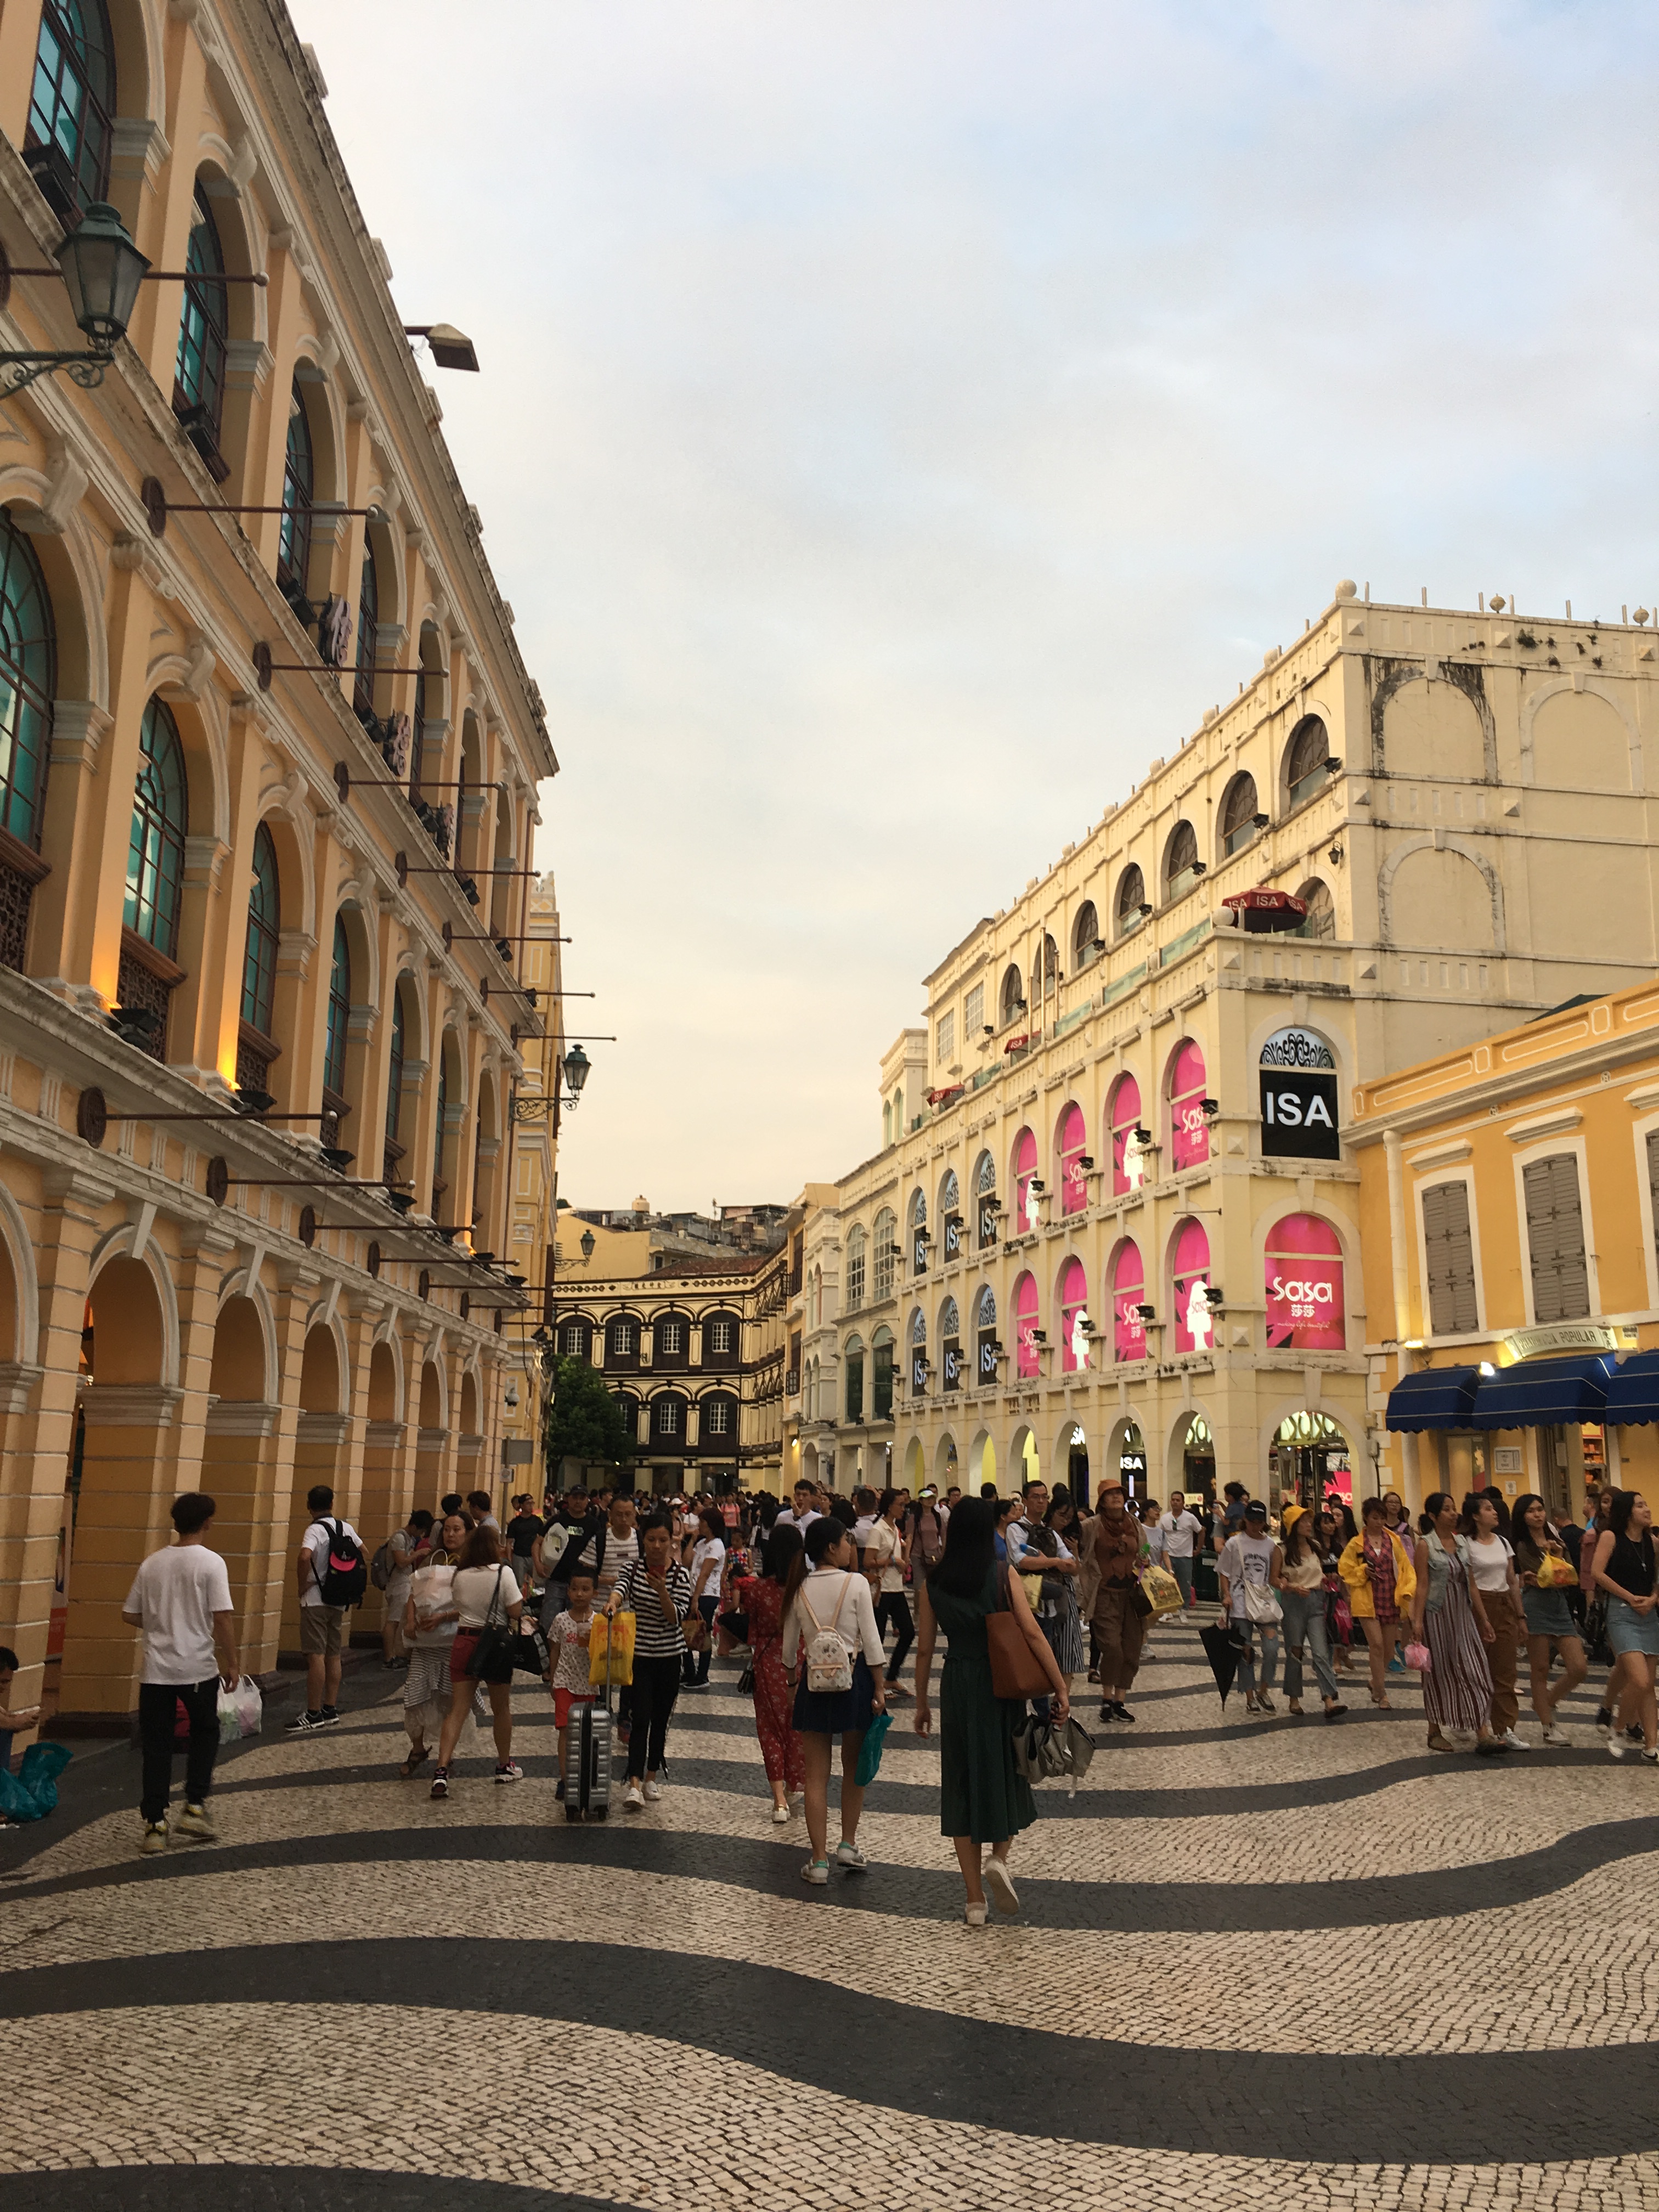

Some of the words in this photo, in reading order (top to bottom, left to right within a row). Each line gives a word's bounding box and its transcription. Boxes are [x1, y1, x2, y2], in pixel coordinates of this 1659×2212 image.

[1229, 898, 1247, 911] ISA
[1256, 896, 1278, 906] ISA
[1288, 898, 1303, 911] ISA
[1266, 1092, 1334, 1128] ISA
[916, 1240, 927, 1265] IS
[1291, 1304, 1315, 1317] 莎莎
[1559, 1330, 1597, 1344] POPULAR
[1120, 1457, 1143, 1470] ISA
